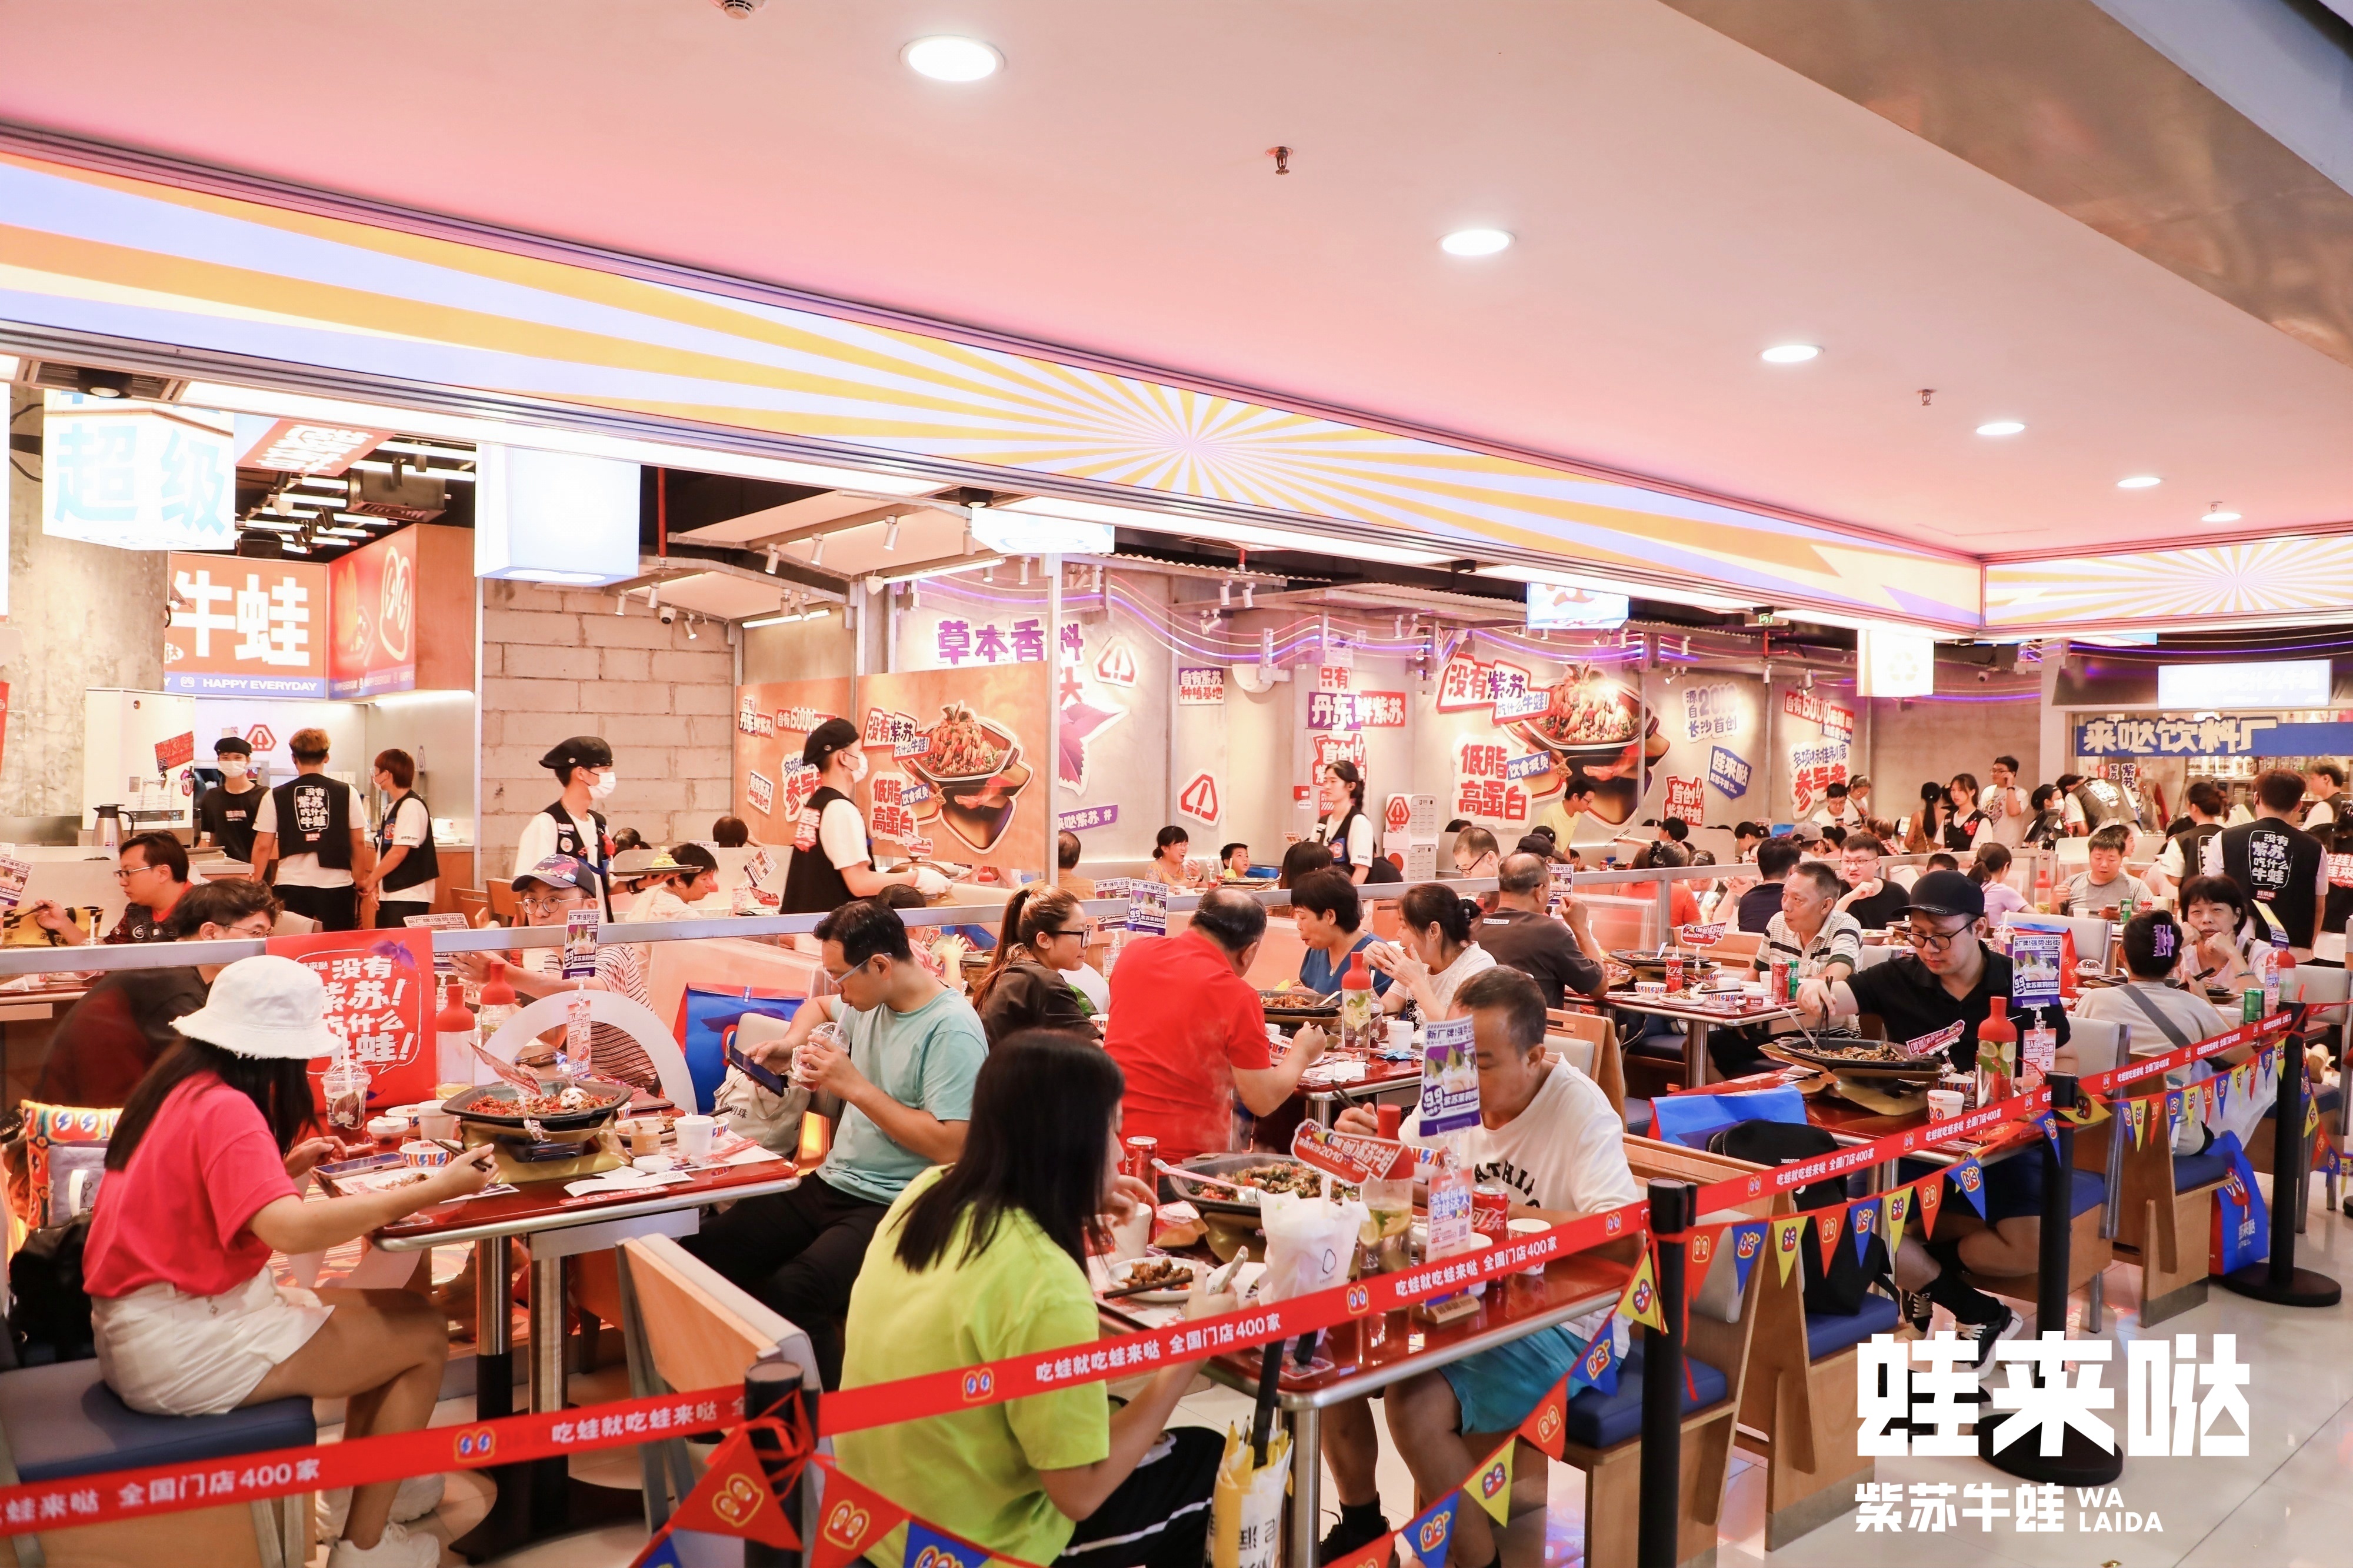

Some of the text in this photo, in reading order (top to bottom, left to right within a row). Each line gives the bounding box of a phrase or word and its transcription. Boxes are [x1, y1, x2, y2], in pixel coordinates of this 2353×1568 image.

[55, 423, 225, 536] 超级
[171, 570, 310, 666] 牛蛙
[202, 678, 318, 692] HAPPY EVERYDAY
[1180, 669, 1224, 685] 自有紫苏
[1320, 668, 1348, 690] 只有
[1448, 664, 1526, 700] 没有紫苏
[1180, 686, 1224, 700] 种植基地
[1498, 693, 1548, 716] 吃什么牛蛙!
[1311, 694, 1405, 727] 丹东鲜紫苏
[868, 715, 914, 743] 没有紫苏
[1688, 715, 1737, 738] 长沙首创
[2084, 719, 2277, 755] 来哒饮料厂
[895, 737, 928, 756] 吃什么牛蛙!
[1461, 743, 1508, 780] 低脂
[1508, 754, 1550, 778] 饮食减负
[1712, 749, 1749, 787] 蛙来哒
[297, 796, 324, 809] 紫苏
[305, 788, 325, 797] 没有
[873, 778, 901, 806] 低脂
[901, 785, 929, 806] 饮食减负
[1458, 780, 1527, 820] 高蛋白
[300, 815, 326, 828] 牛蛙
[872, 806, 914, 838] 高蛋白
[2252, 842, 2285, 859] 紫苏
[2264, 833, 2289, 846] 没有
[2251, 868, 2284, 884] 牛蛙
[2253, 858, 2289, 870] 吃什么
[331, 955, 392, 980] 没有
[1925, 1107, 2002, 1142] 吃蛙就吃蛙来哒 全国门店400家
[1776, 1147, 1875, 1186] 吃蛙就吃蛙来哒 全国门店400家
[1395, 1259, 1478, 1298] 吃蛙就吃蛙来哒
[1483, 1236, 1557, 1272] 全国门店400家
[1035, 1312, 1281, 1383] 吃蛙就吃蛙来哒 全国门店400家
[552, 1401, 717, 1443] 吃蛙就吃蛙来哒
[118, 1459, 321, 1508] 全国门店400家
